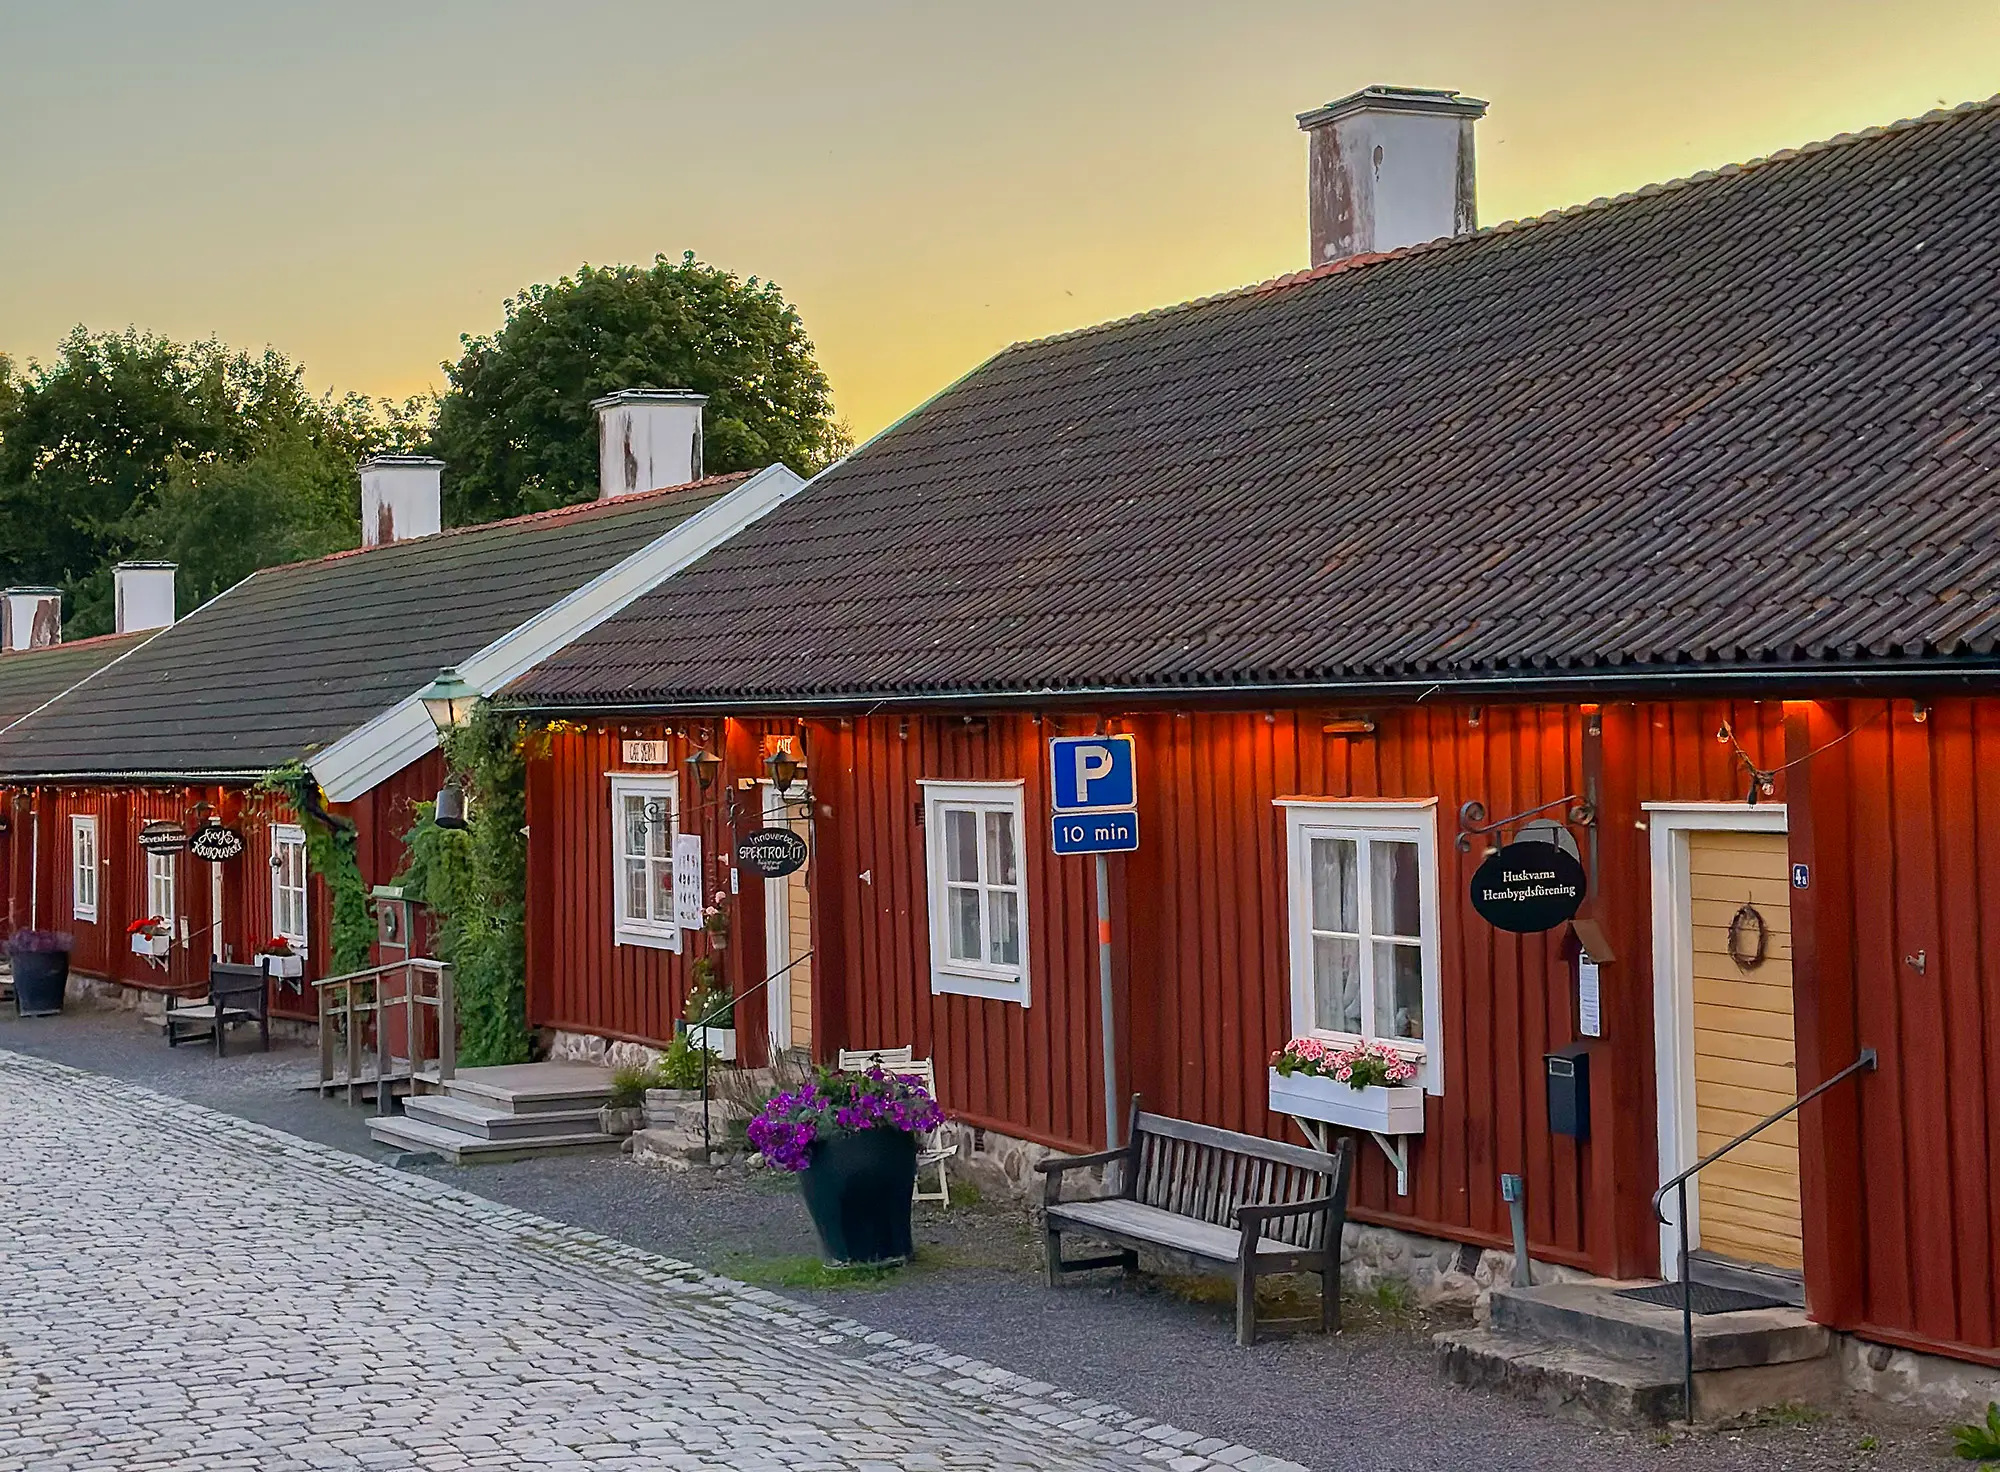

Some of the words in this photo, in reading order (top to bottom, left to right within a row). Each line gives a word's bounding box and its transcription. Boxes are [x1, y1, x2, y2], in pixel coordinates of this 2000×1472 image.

[1075, 746, 1113, 802] P
[1063, 826, 1084, 843] 10
[1095, 823, 1128, 841] min
[1503, 870, 1555, 882] Huskvarna
[1483, 884, 1576, 902] Hembygdsförening
